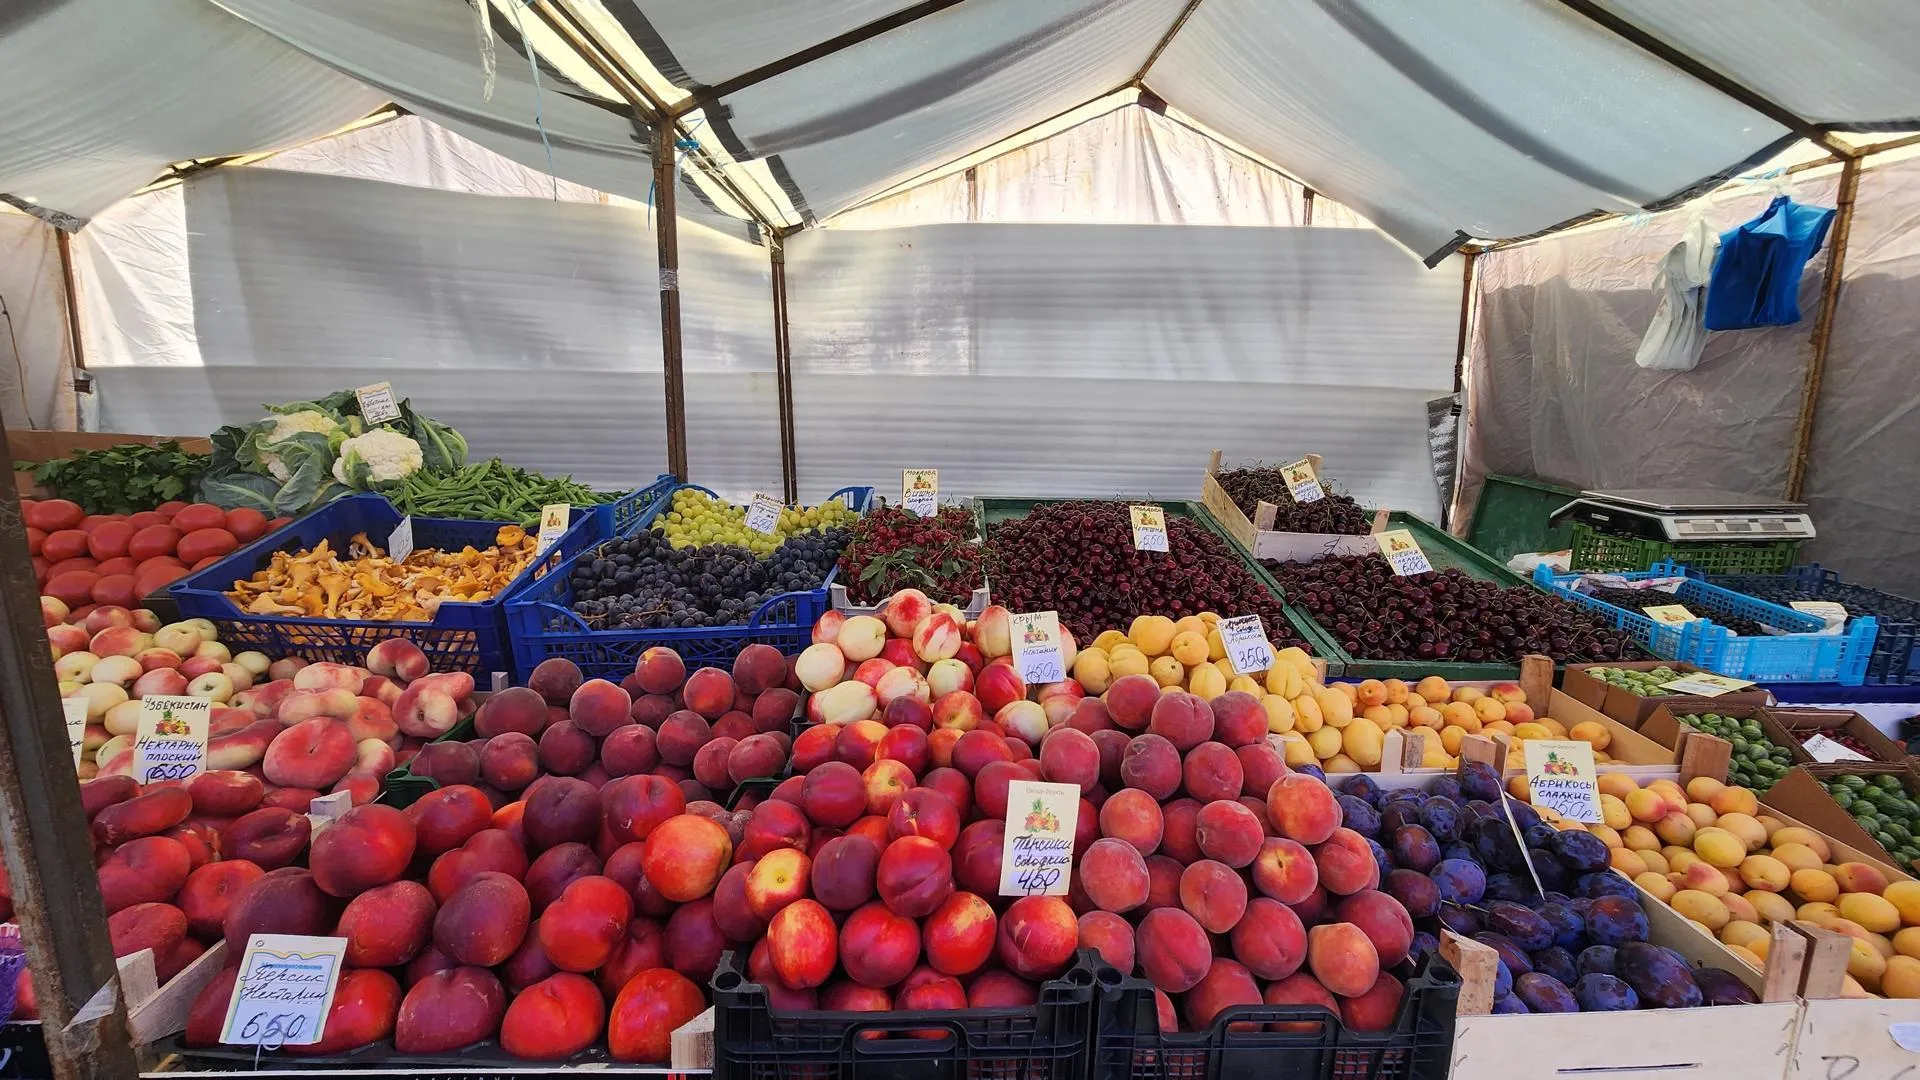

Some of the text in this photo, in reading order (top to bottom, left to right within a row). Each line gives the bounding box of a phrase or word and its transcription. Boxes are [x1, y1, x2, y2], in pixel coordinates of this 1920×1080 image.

[144, 697, 208, 711] УЗБЕКИСТАН
[1530, 775, 1595, 790] АБРИКОСЫ
[1539, 790, 1591, 801] СЛАДКИЕ
[241, 1011, 306, 1039] 650
